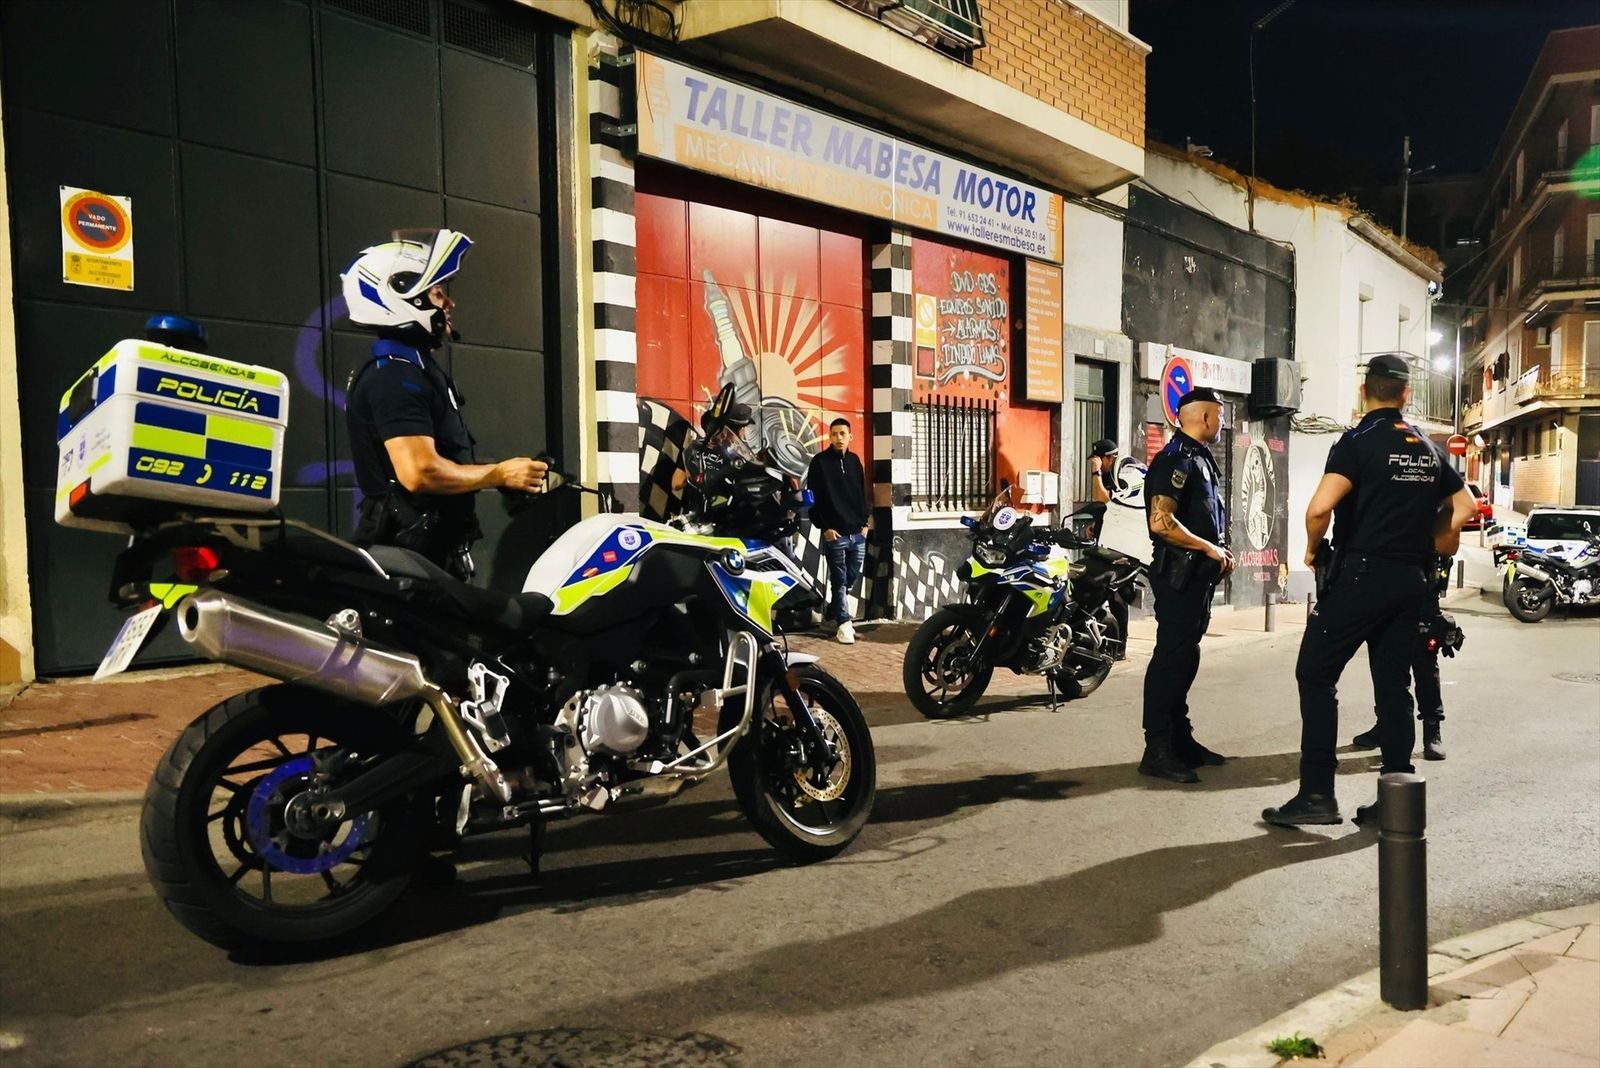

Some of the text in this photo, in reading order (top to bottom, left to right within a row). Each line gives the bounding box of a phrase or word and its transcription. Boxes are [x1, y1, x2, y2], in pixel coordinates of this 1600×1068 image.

[685, 77, 1036, 223] TALLER MABESA MOTOR
[78, 220, 117, 232] PERMANENTE
[88, 214, 106, 222] VADO
[959, 209, 966, 219] 91
[967, 211, 978, 223] 653
[979, 215, 987, 225] 24
[988, 218, 994, 227] 41
[1014, 225, 1023, 235] 654
[1024, 228, 1031, 238] 30
[1032, 230, 1038, 240] 51
[1039, 232, 1046, 242] 04
[947, 220, 1046, 255] www.talleresmabesa.es
[161, 352, 257, 380] ALCOBENDAS
[156, 377, 259, 412] POLICÍA
[136, 456, 267, 490] 092 112
